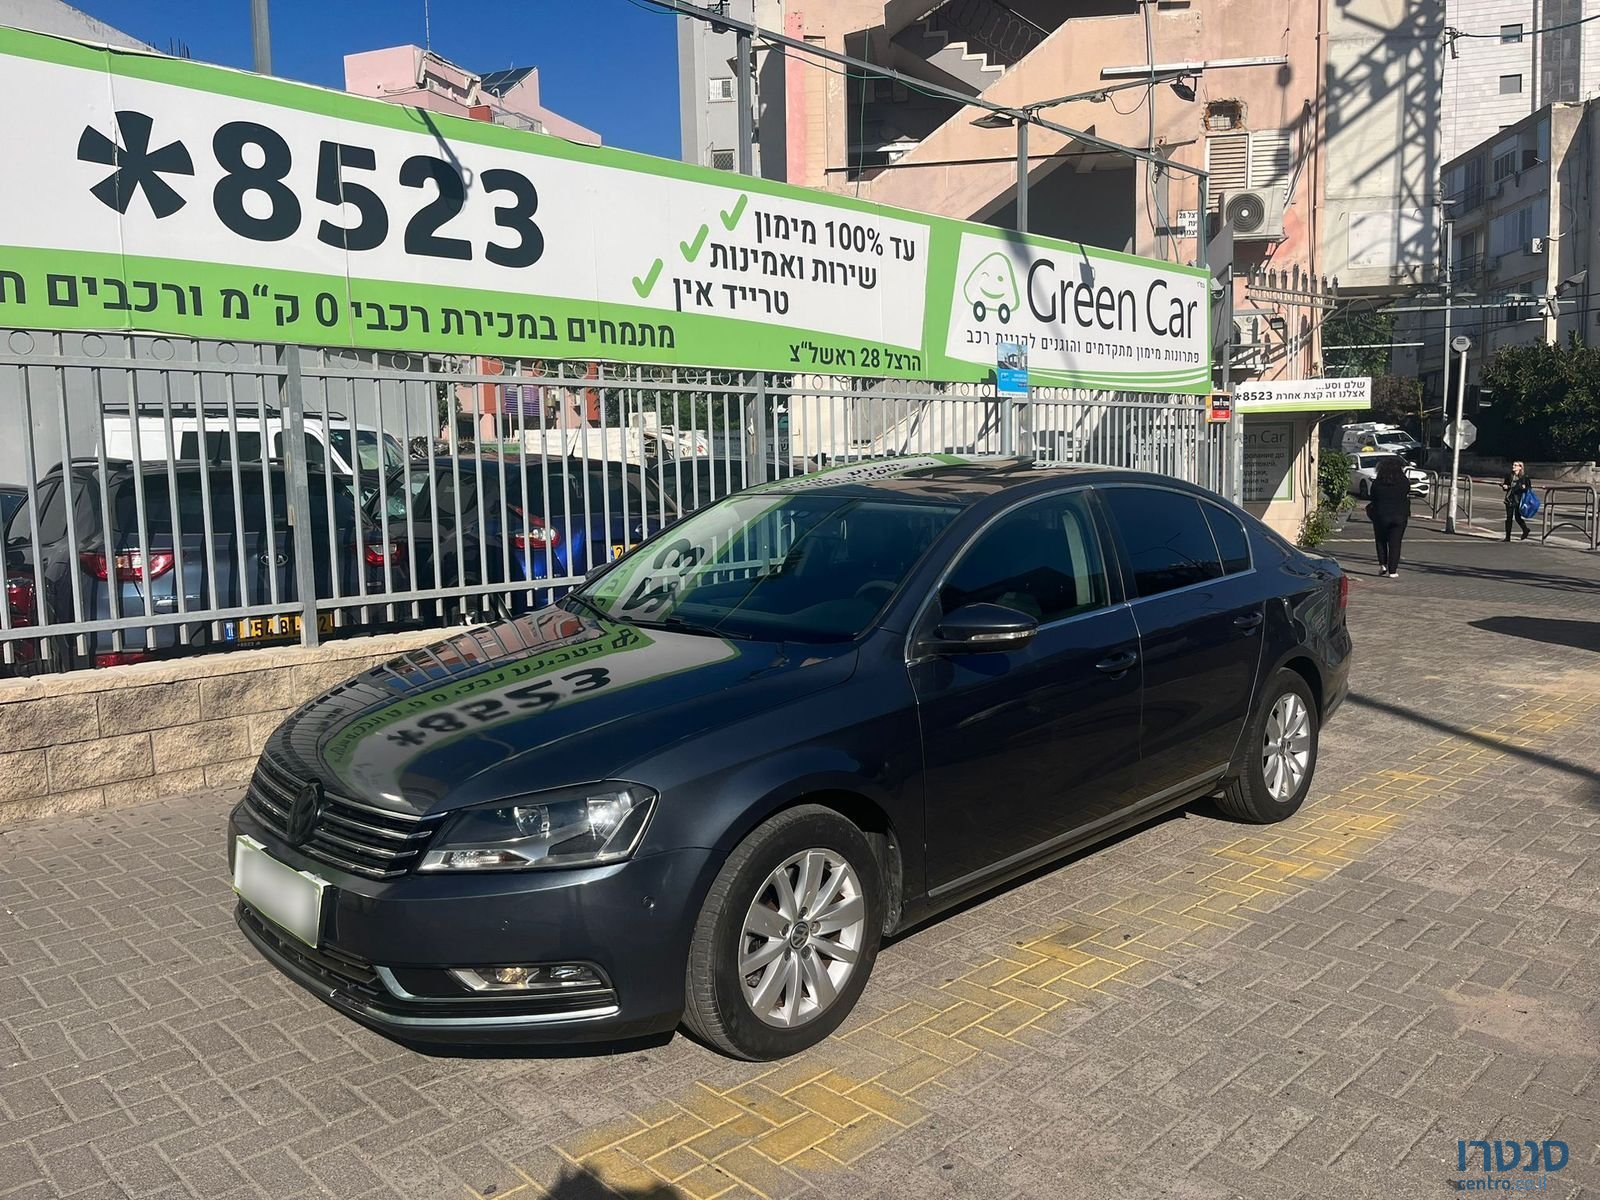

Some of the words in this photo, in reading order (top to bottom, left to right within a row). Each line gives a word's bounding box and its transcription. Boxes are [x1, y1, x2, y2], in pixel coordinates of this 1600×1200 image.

[755, 212, 816, 244] מימון
[826, 221, 883, 255] 100%
[710, 242, 803, 279] ואמינות
[890, 237, 914, 261] עד
[812, 259, 876, 289] שירות
[47, 274, 202, 315] ורכבים
[673, 279, 713, 312] אין
[723, 284, 788, 314] טרייד
[1027, 258, 1137, 333] Green
[1146, 279, 1198, 338] Car
[316, 293, 338, 326] 0
[351, 302, 429, 332] רכבי
[442, 309, 557, 340] במכירת
[568, 318, 674, 348] מתמחים
[967, 330, 989, 344] רכב
[861, 348, 879, 367] 28
[1042, 338, 1080, 352] והוגנים
[1086, 342, 1132, 358] מתקדמים
[1137, 347, 1160, 360] מימון
[1165, 350, 1198, 363] פתרונות
[885, 349, 920, 371] הרצל
[1276, 392, 1301, 400] אחרת
[1304, 390, 1323, 400] קצת
[1339, 389, 1365, 398] אצלנו
[1344, 381, 1365, 389] שלם
